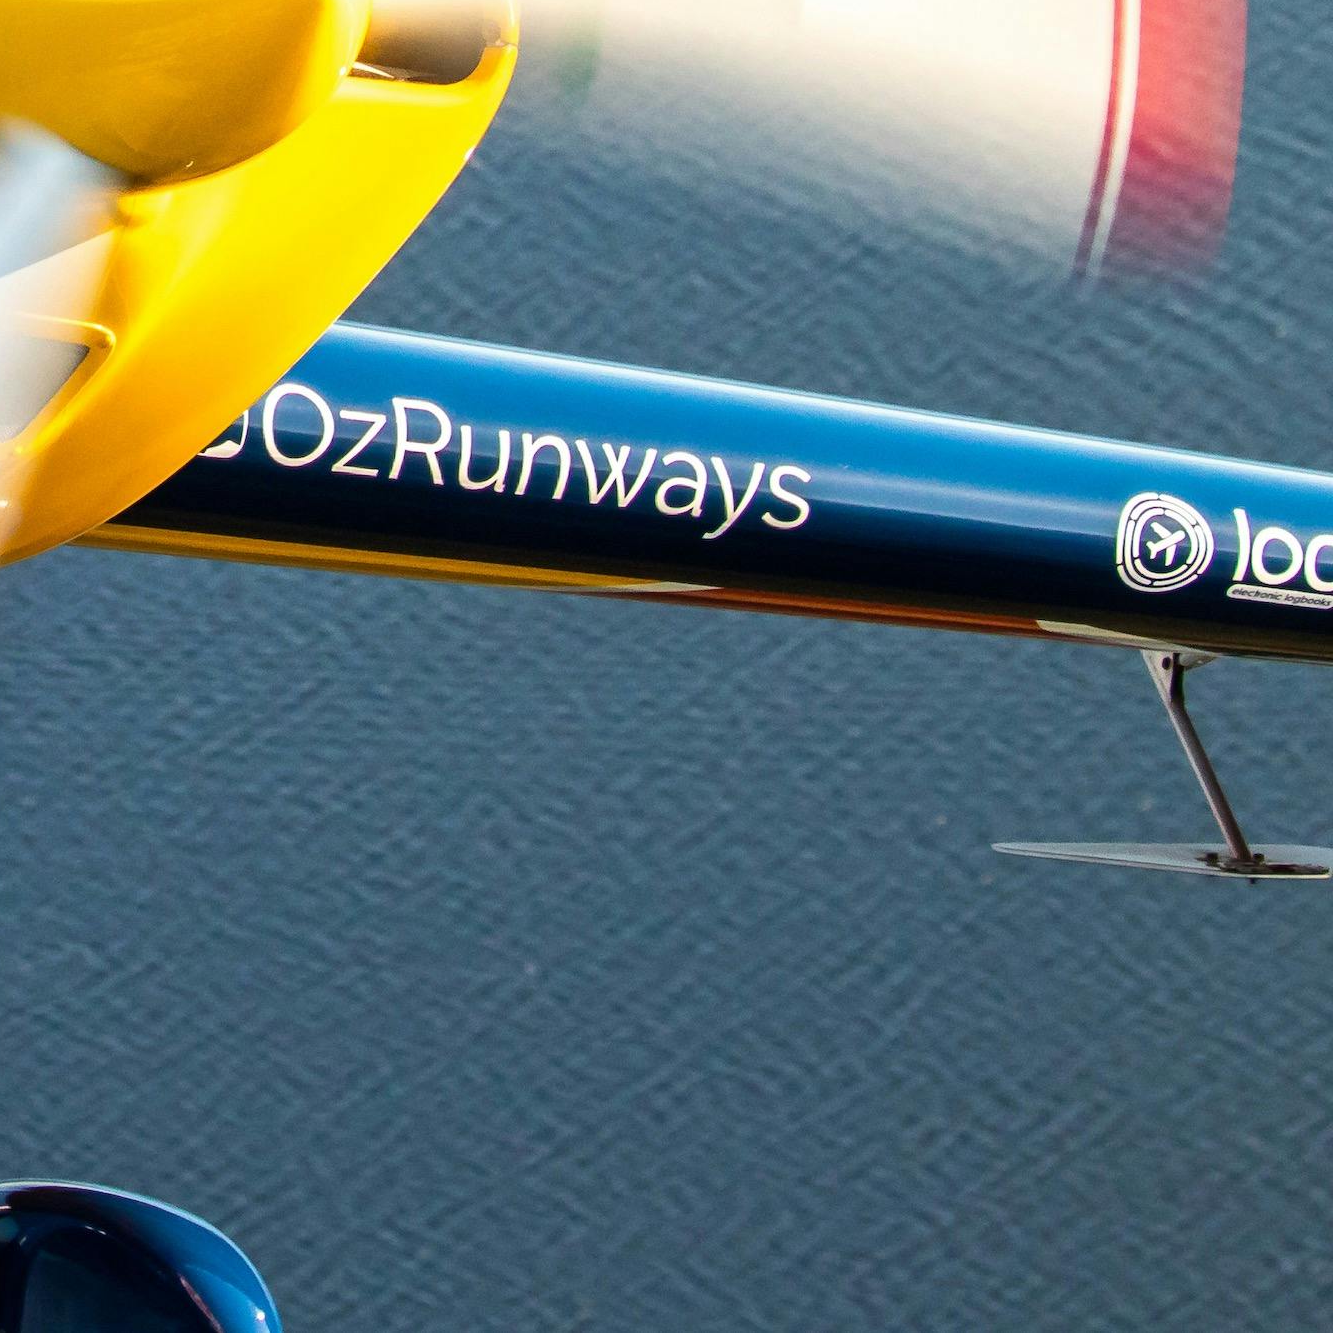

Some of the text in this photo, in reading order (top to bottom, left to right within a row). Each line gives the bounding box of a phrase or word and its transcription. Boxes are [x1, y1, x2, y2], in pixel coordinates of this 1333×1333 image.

[262, 383, 812, 539] OzRunways
[1232, 587, 1332, 607] electronic logbooks
